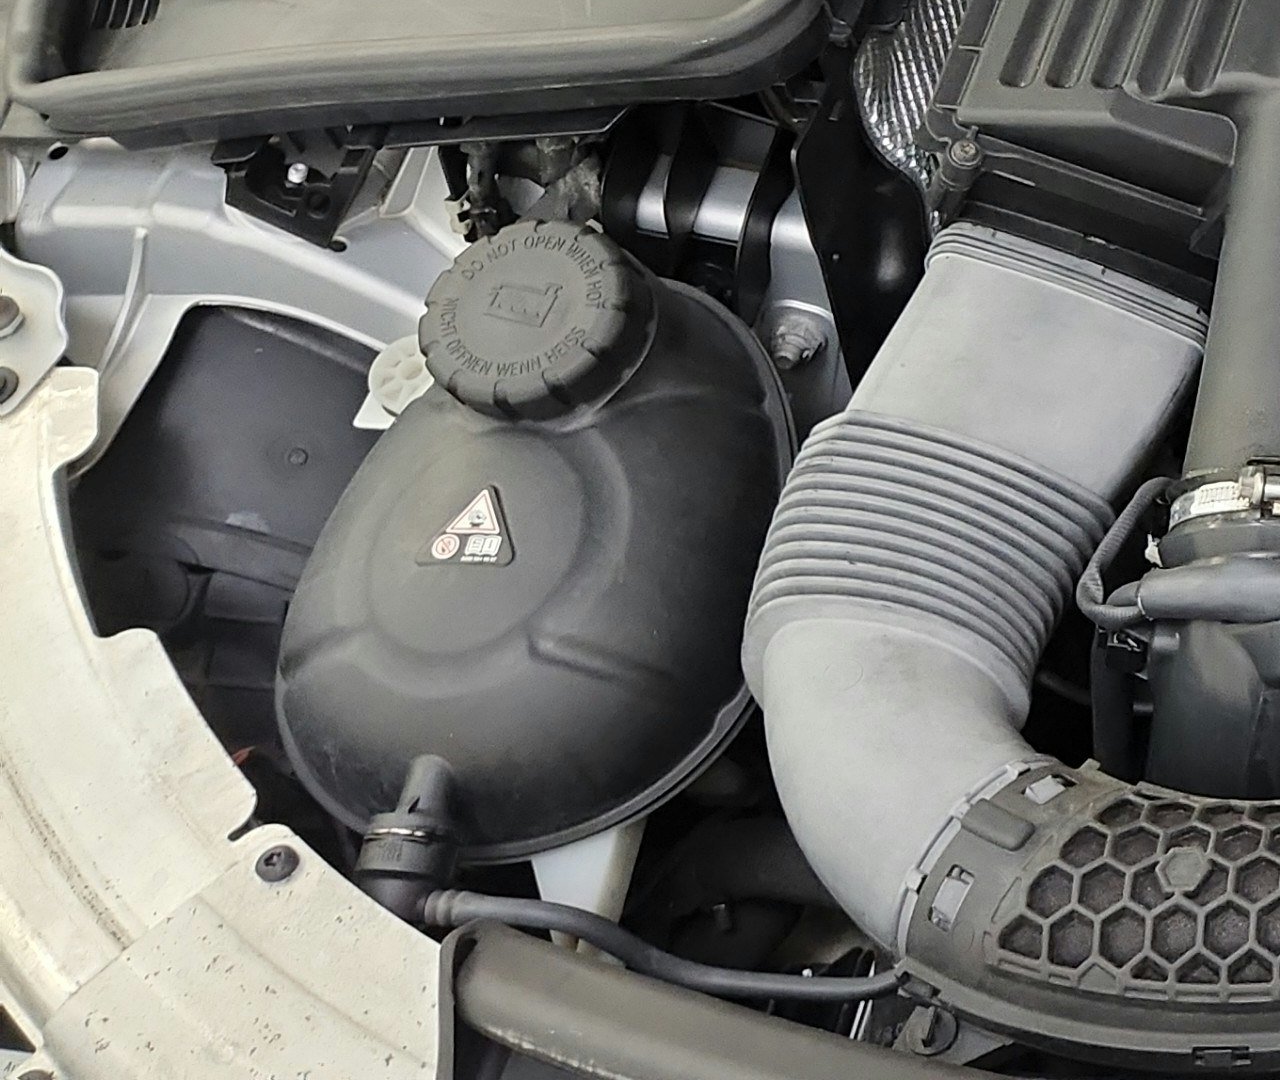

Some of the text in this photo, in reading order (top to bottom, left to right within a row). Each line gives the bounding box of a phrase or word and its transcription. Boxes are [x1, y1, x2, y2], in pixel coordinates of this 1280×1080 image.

[461, 236, 602, 309] DO NOT OPEN WHEN HOT
[440, 297, 459, 338] NICHT
[496, 354, 542, 377] WENN
[545, 326, 586, 364] HEISS
